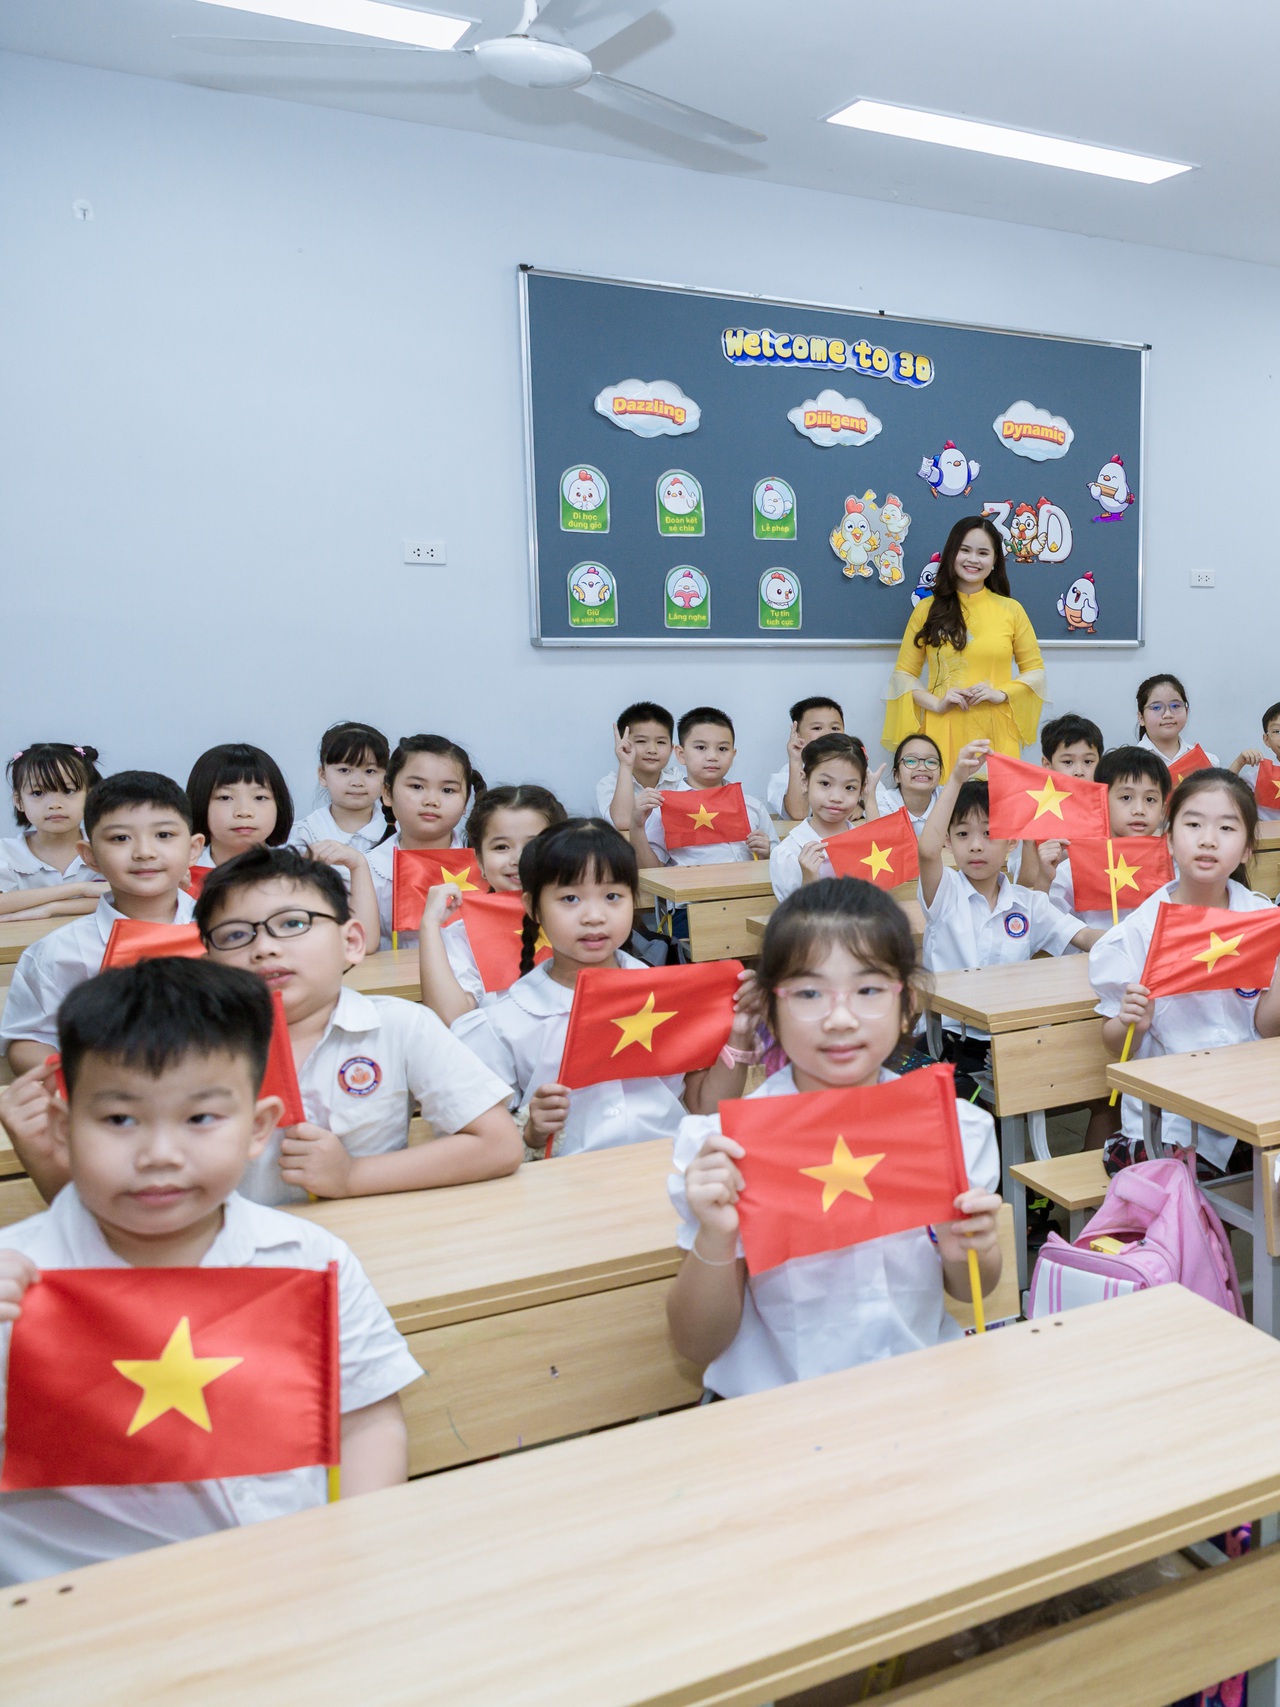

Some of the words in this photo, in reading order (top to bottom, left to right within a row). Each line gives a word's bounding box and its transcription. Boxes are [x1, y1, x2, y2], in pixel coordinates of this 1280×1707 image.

[724, 328, 848, 366] Welcome
[854, 341, 891, 373] to
[898, 351, 933, 383] 3D
[612, 397, 686, 426] Dazzling
[804, 410, 868, 434] Diligent
[1002, 421, 1066, 446] Dynamic
[688, 613, 707, 621] nghe
